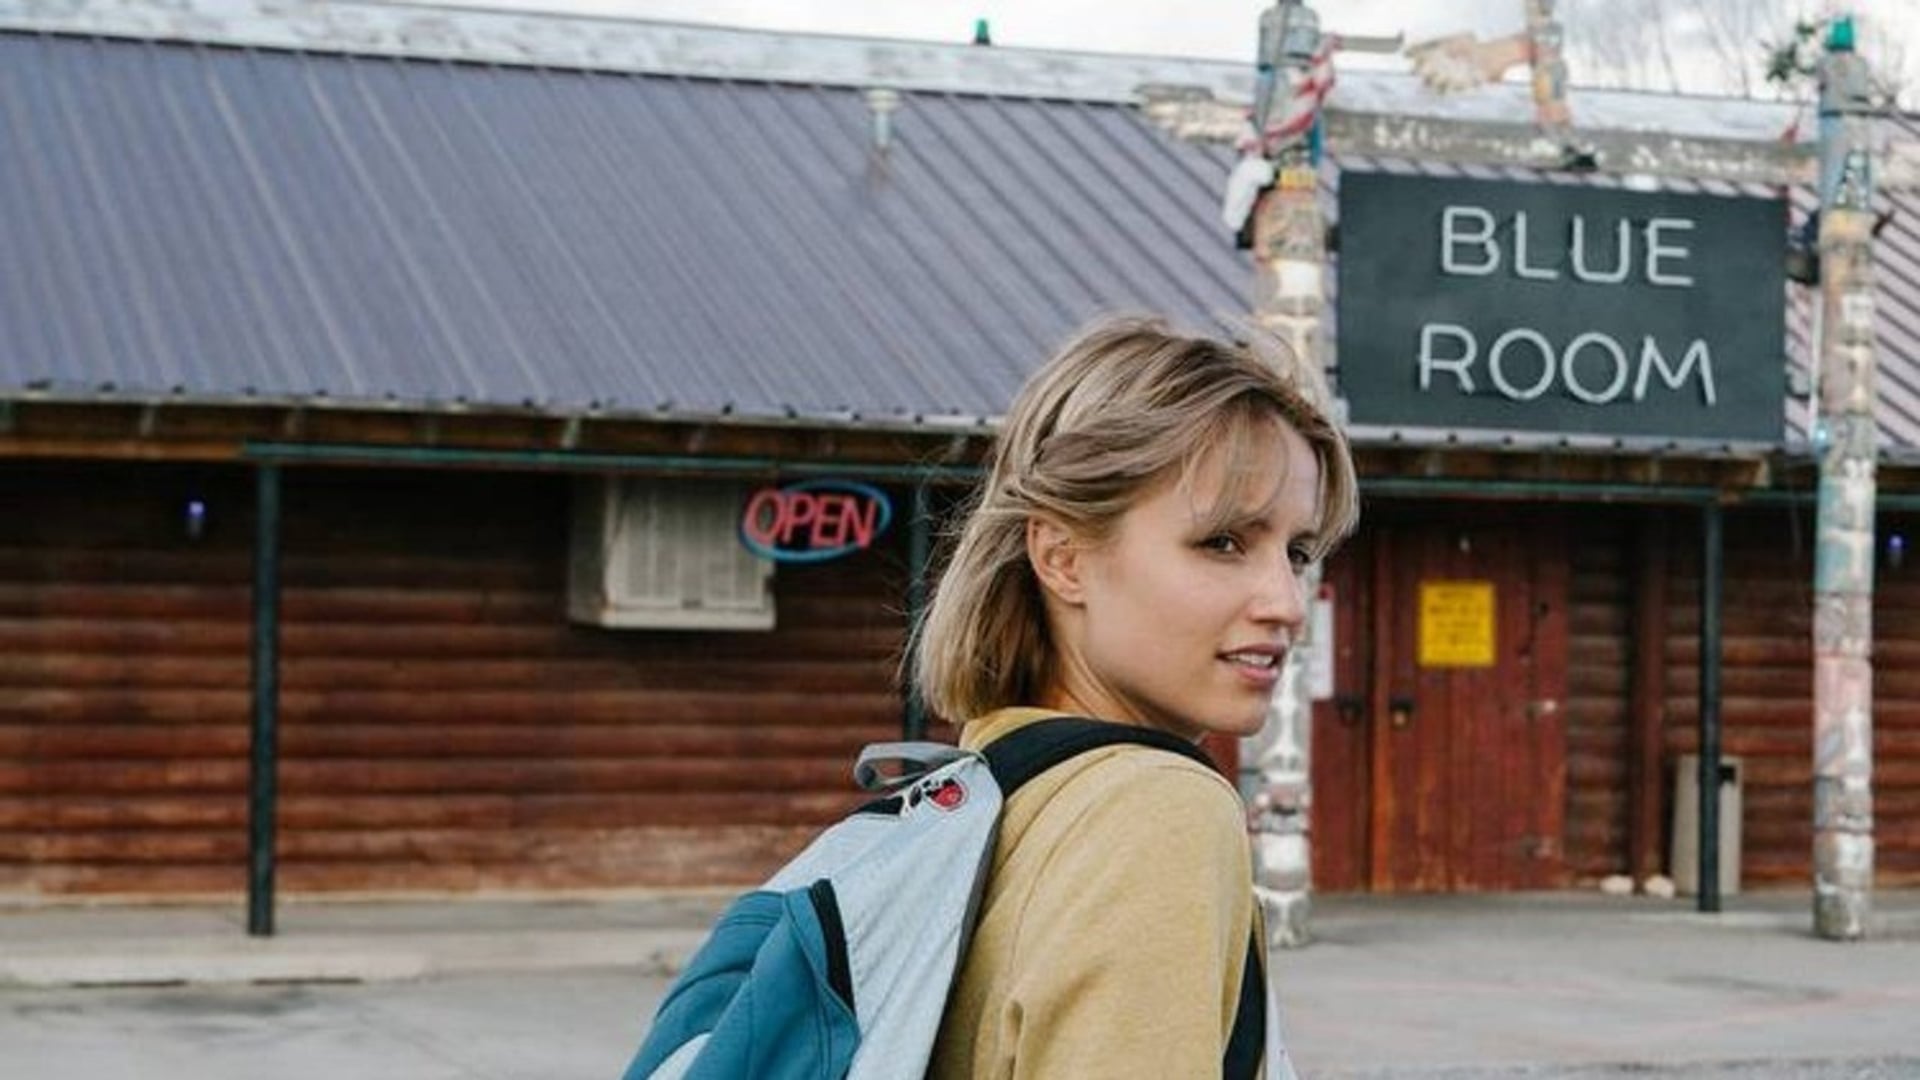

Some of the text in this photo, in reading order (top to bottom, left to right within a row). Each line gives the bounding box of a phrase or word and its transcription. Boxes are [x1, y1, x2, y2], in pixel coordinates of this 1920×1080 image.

[1442, 206, 1694, 286] BLUE
[1418, 324, 1716, 406] ROOM
[744, 489, 877, 548] OPEN
